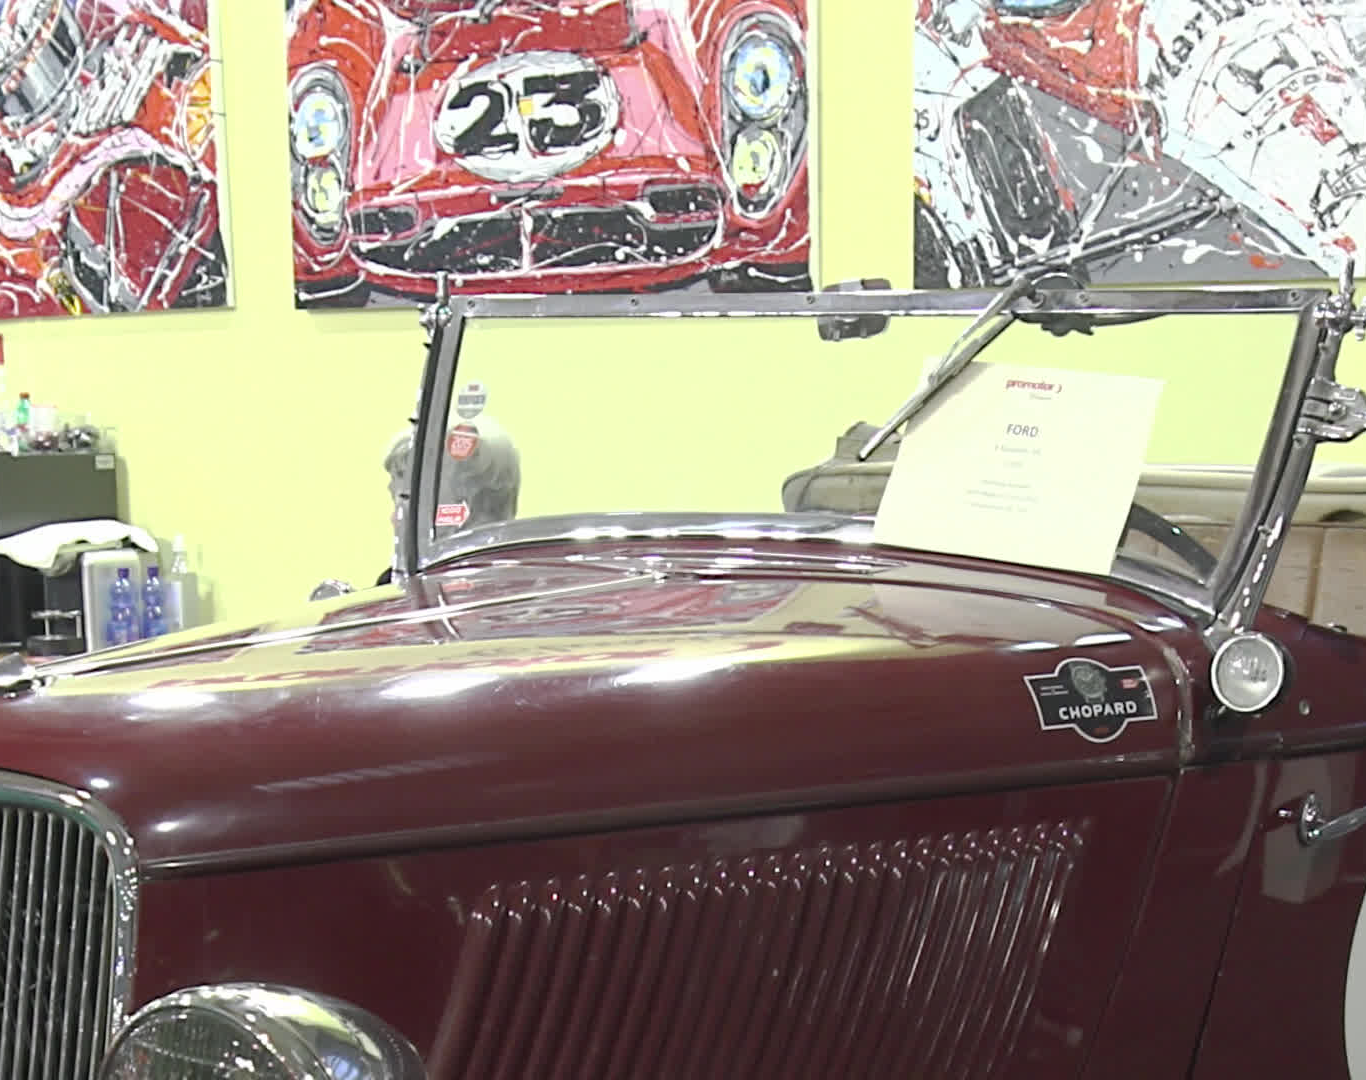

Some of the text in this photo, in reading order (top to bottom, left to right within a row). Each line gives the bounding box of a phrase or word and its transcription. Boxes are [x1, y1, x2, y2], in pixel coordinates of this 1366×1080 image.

[448, 72, 603, 155] 23
[1006, 423, 1039, 438] FORD
[1058, 701, 1138, 720] CHOPARD
